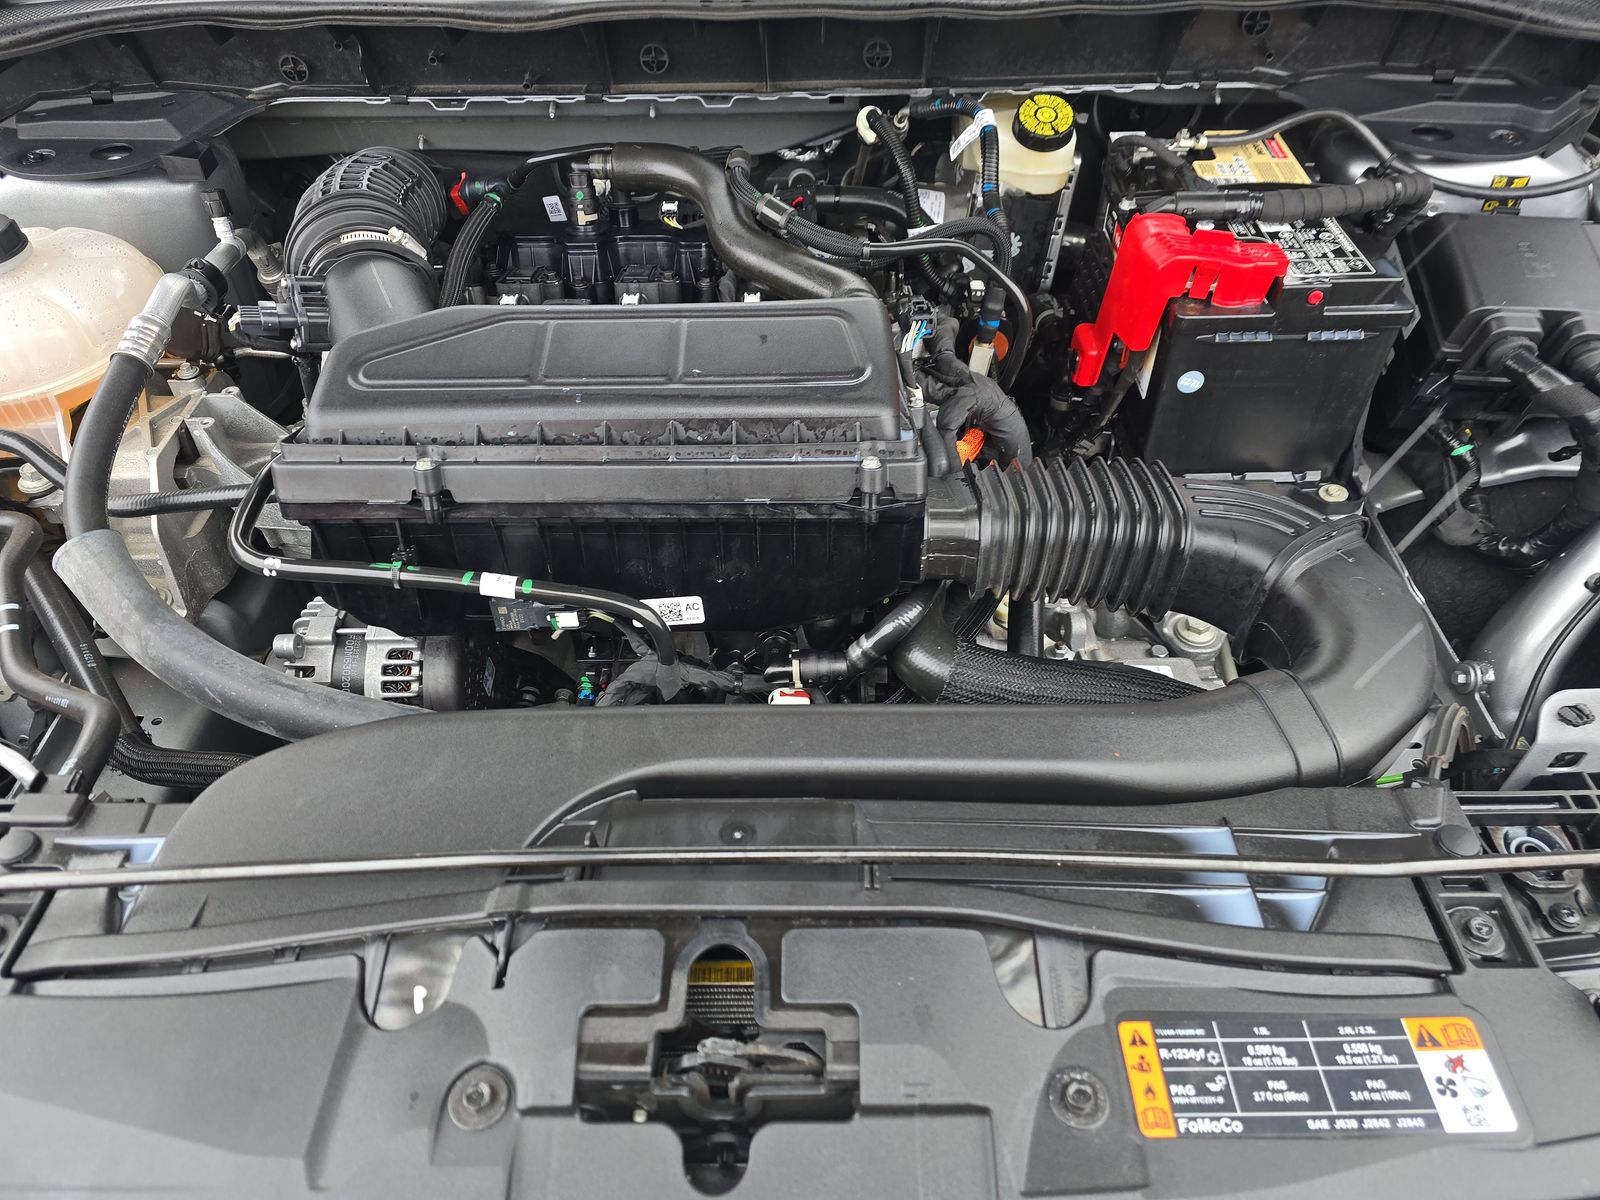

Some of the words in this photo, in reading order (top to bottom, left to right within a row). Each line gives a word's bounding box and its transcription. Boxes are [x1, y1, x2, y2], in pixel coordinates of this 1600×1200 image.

[685, 602, 700, 611] AC
[1159, 1047, 1206, 1062] R-1234yf
[1169, 1084, 1197, 1096] PAG
[1266, 1079, 1288, 1091] PAG
[1365, 1079, 1387, 1090] PAG
[1177, 1117, 1244, 1133] FoMoCo
[1306, 1118, 1331, 1130] SAE
